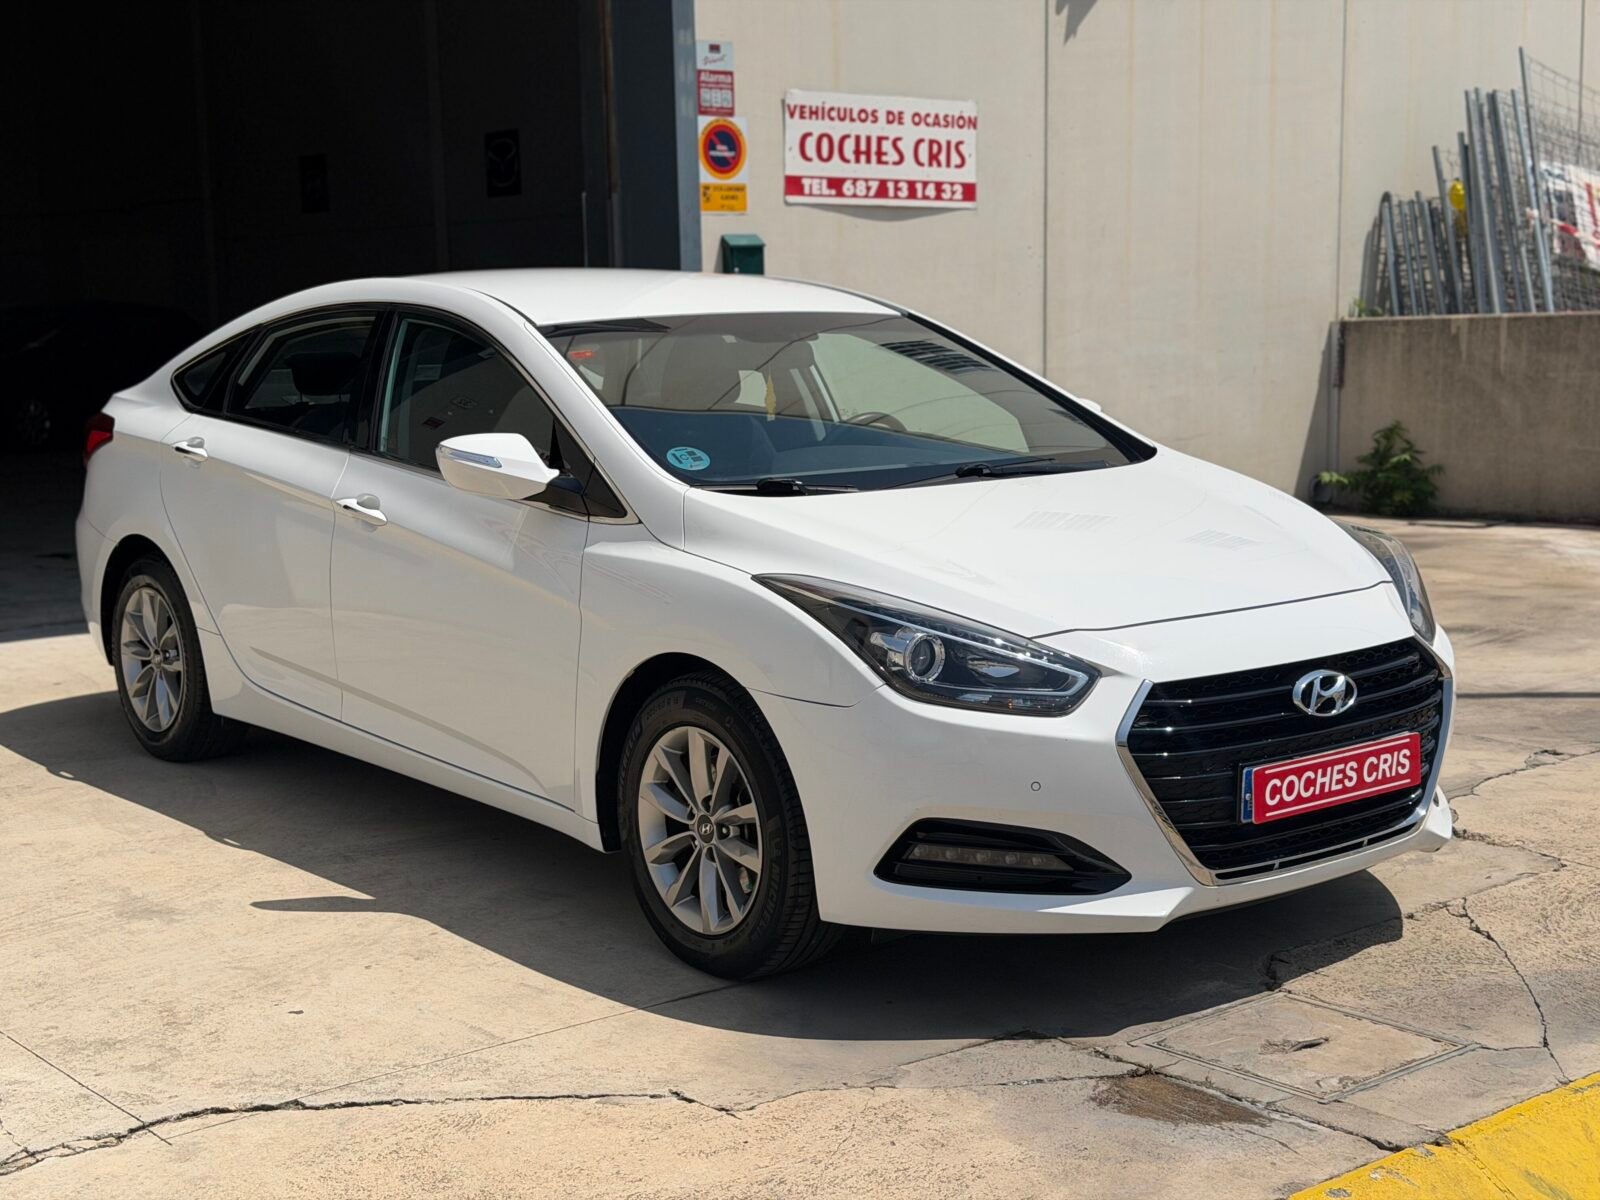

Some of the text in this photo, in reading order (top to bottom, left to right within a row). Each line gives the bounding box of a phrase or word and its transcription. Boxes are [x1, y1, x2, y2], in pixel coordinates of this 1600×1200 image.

[786, 101, 978, 131] VEHÍCULOS DE OCASIÓN
[798, 131, 967, 170] COCHES CRIS
[801, 177, 963, 201] TEL. 687 13 14 32
[1265, 749, 1411, 806] COCHES CRIS
